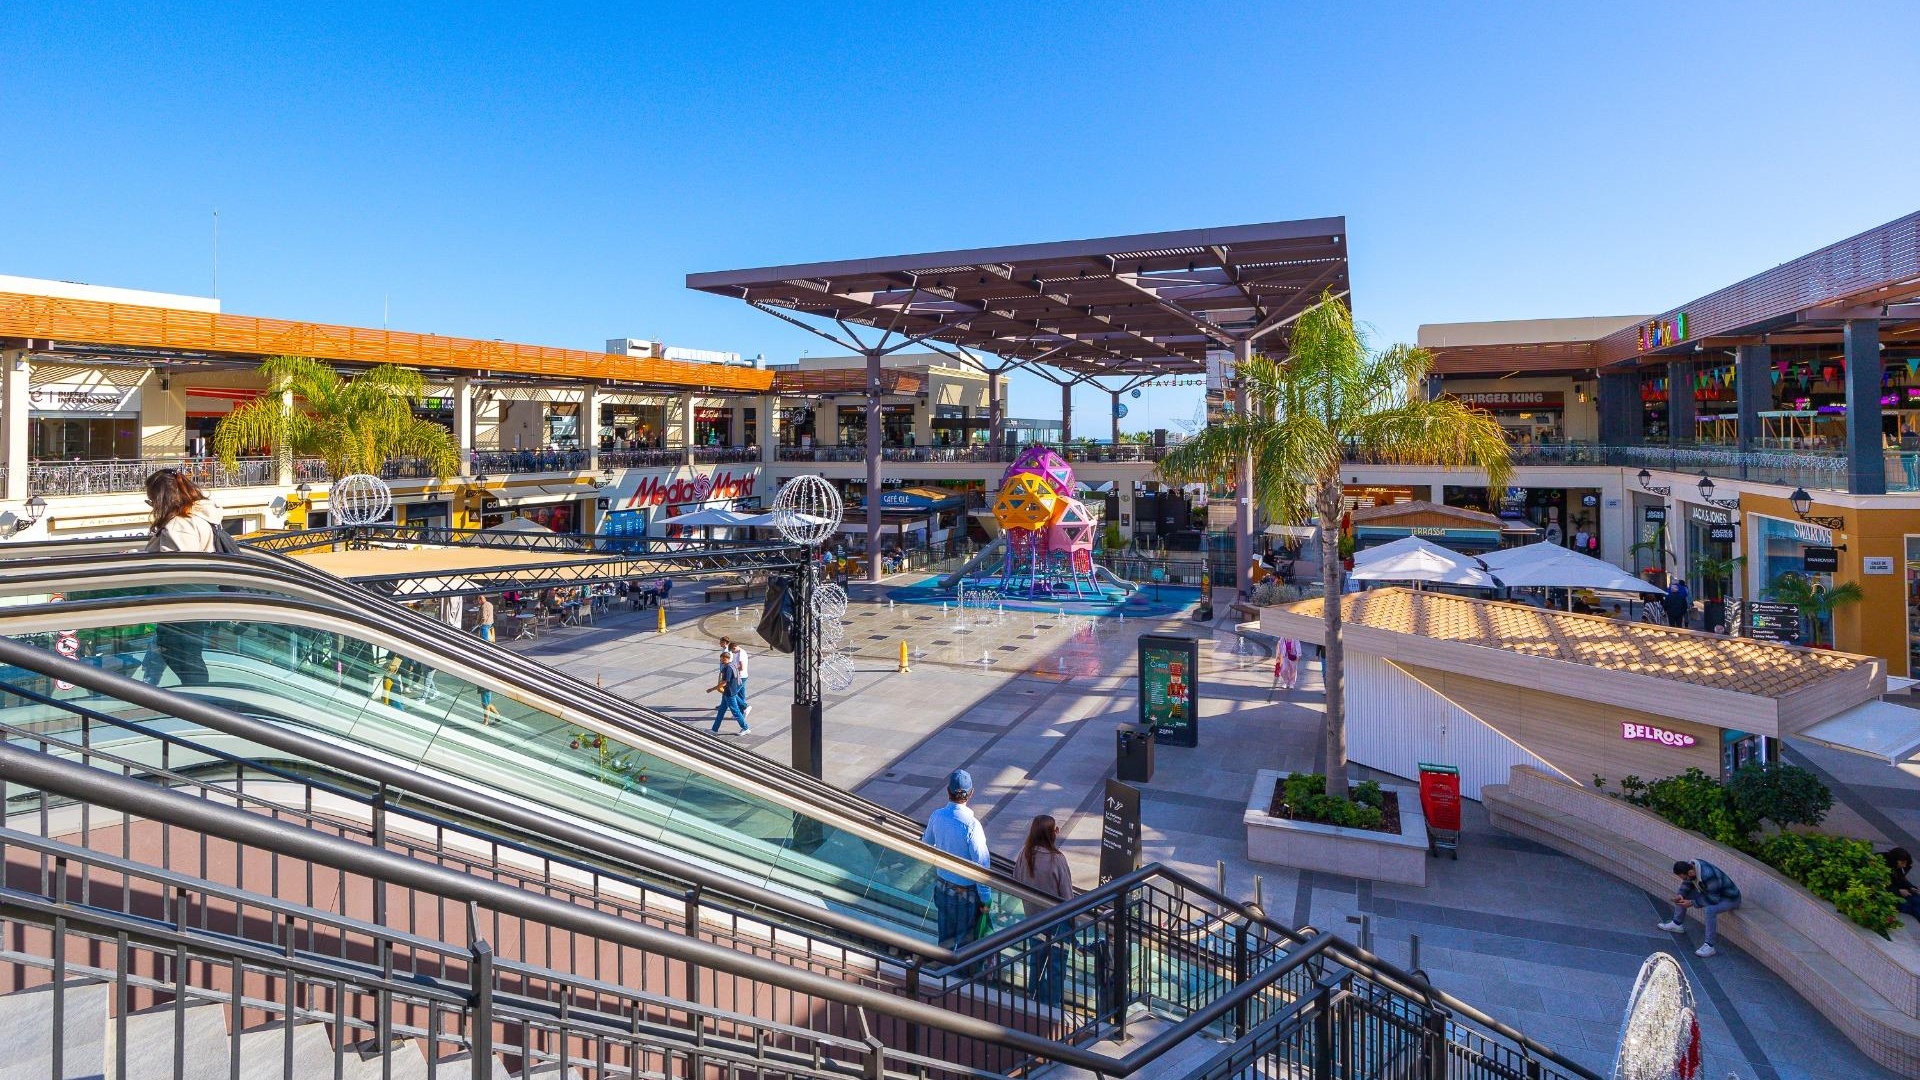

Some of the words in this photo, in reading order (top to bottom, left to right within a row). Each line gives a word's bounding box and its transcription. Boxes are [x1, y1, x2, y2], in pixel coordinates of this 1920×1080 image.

[1460, 393, 1509, 404] BURGER
[1511, 392, 1544, 403] KING
[628, 476, 694, 508] Media
[707, 471, 756, 499] Markt
[883, 495, 897, 503] CAFÉ
[898, 495, 909, 503] OLÉ
[1411, 527, 1446, 536] TERRASSA
[1794, 523, 1832, 545] SWAROVS
[1751, 603, 1759, 612] 2
